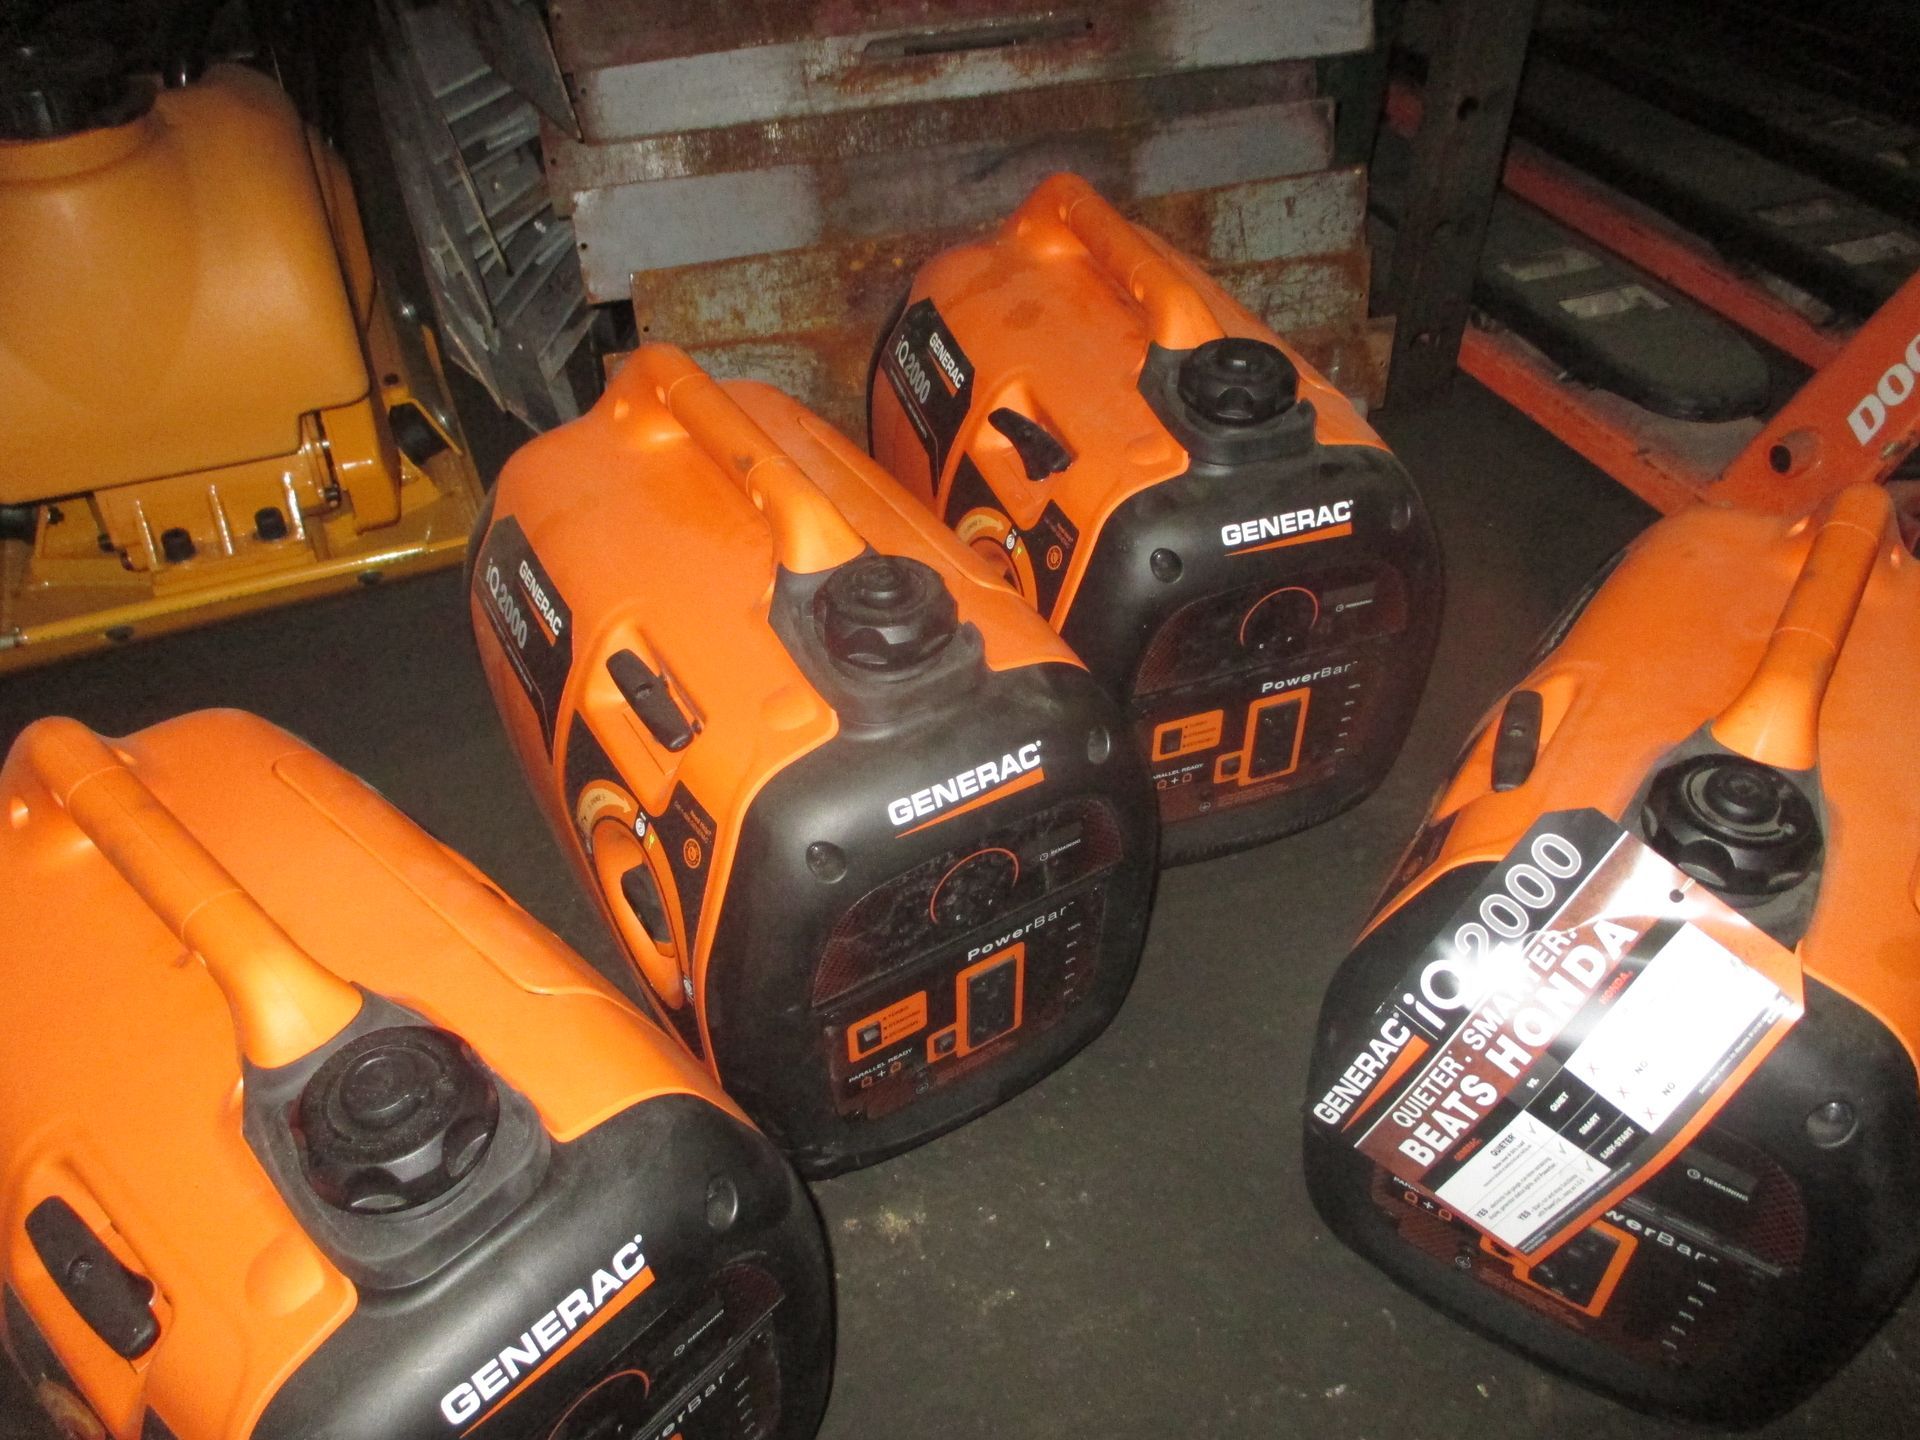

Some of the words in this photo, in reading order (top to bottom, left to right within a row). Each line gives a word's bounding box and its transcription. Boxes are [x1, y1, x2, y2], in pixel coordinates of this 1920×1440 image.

[894, 335, 931, 404] iQ2000
[929, 332, 965, 389] GENERAC
[1221, 500, 1353, 546] GENERAC
[485, 557, 528, 649] iQ2000
[518, 560, 562, 636] GENERAC
[887, 740, 1042, 826] GENERAC
[1398, 1073, 1498, 1168] BEATS
[1485, 917, 1640, 1079] HONDA
[1312, 1013, 1411, 1126] GENERAC
[1662, 1082, 1676, 1096] NO
[1550, 1091, 1569, 1112] QUIET
[1578, 1112, 1600, 1136] SMART
[1600, 1126, 1635, 1160] EASY-START
[1475, 1207, 1489, 1219] YES
[1517, 1209, 1531, 1221] YES
[1703, 1177, 1749, 1202] REMAINING
[440, 1235, 645, 1425] GENERAC
